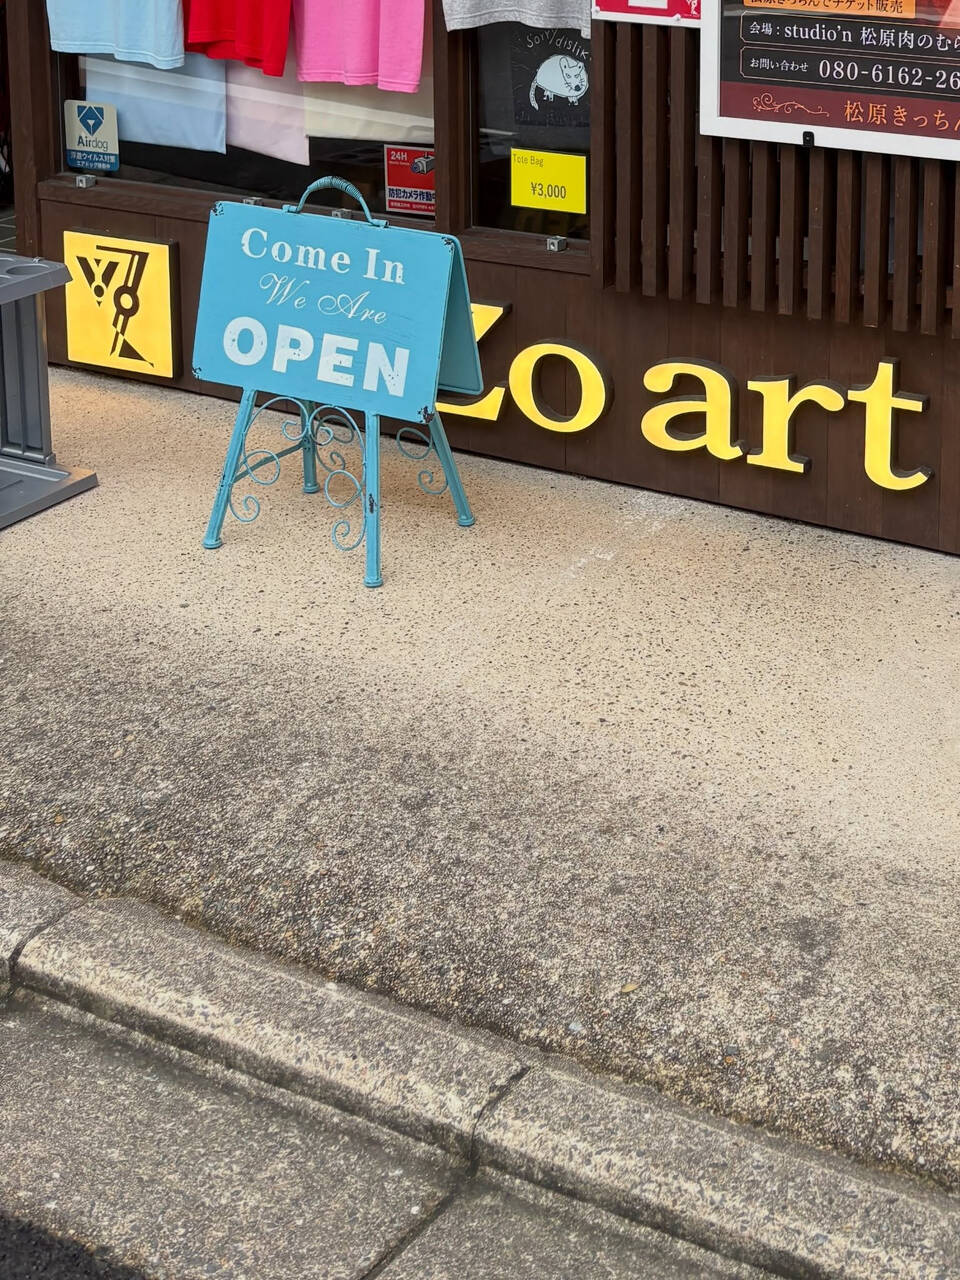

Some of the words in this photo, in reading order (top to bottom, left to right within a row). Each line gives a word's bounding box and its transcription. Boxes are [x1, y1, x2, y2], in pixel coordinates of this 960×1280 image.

[750, 58, 808, 72] お問い合わせ
[77, 135, 108, 152] Airdog
[390, 151, 407, 161] 24H
[513, 153, 529, 165] Tote
[530, 154, 544, 167] Bag
[530, 181, 567, 200] ¥3,000
[241, 227, 351, 274] Come
[363, 247, 406, 285] In
[259, 272, 310, 309] We
[317, 290, 387, 325] Are
[223, 316, 410, 398] OPEN
[640, 361, 930, 491] art
